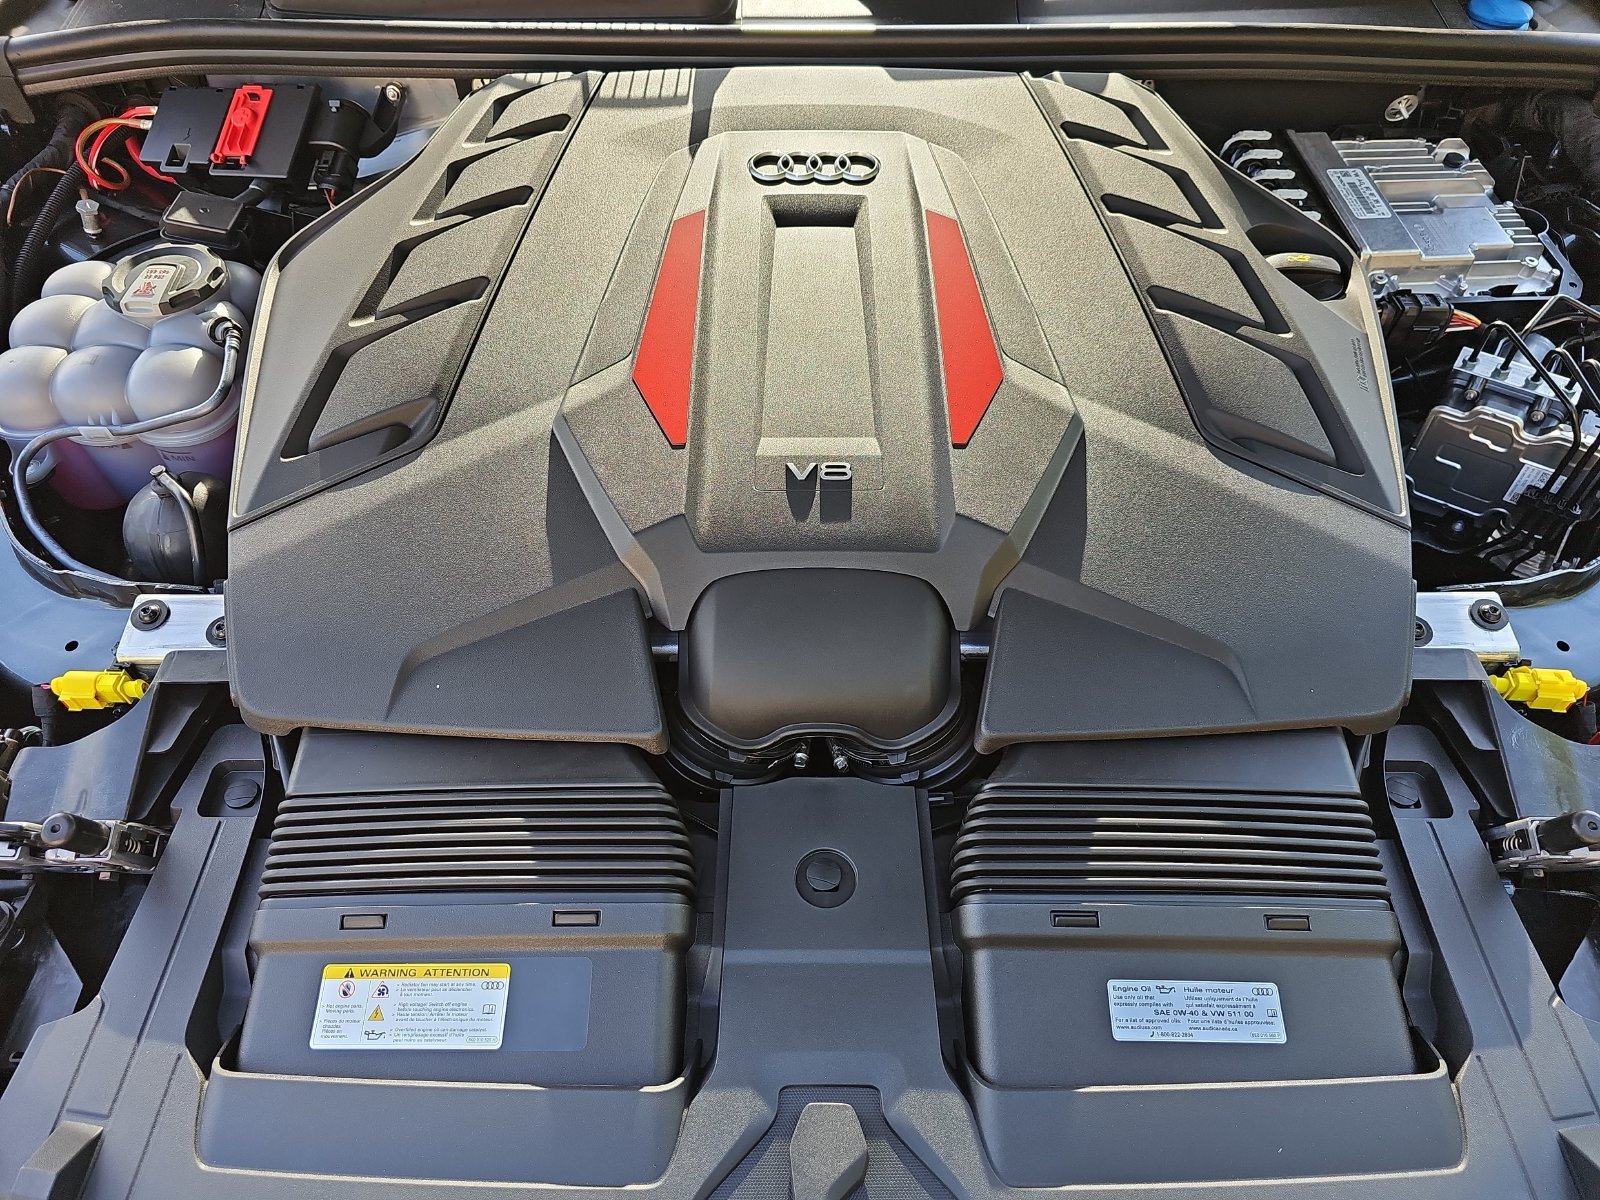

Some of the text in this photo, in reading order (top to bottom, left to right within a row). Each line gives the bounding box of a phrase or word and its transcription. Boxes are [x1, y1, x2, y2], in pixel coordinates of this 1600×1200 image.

[785, 462, 852, 481] V8
[360, 968, 490, 977] WARNING ATTENTION
